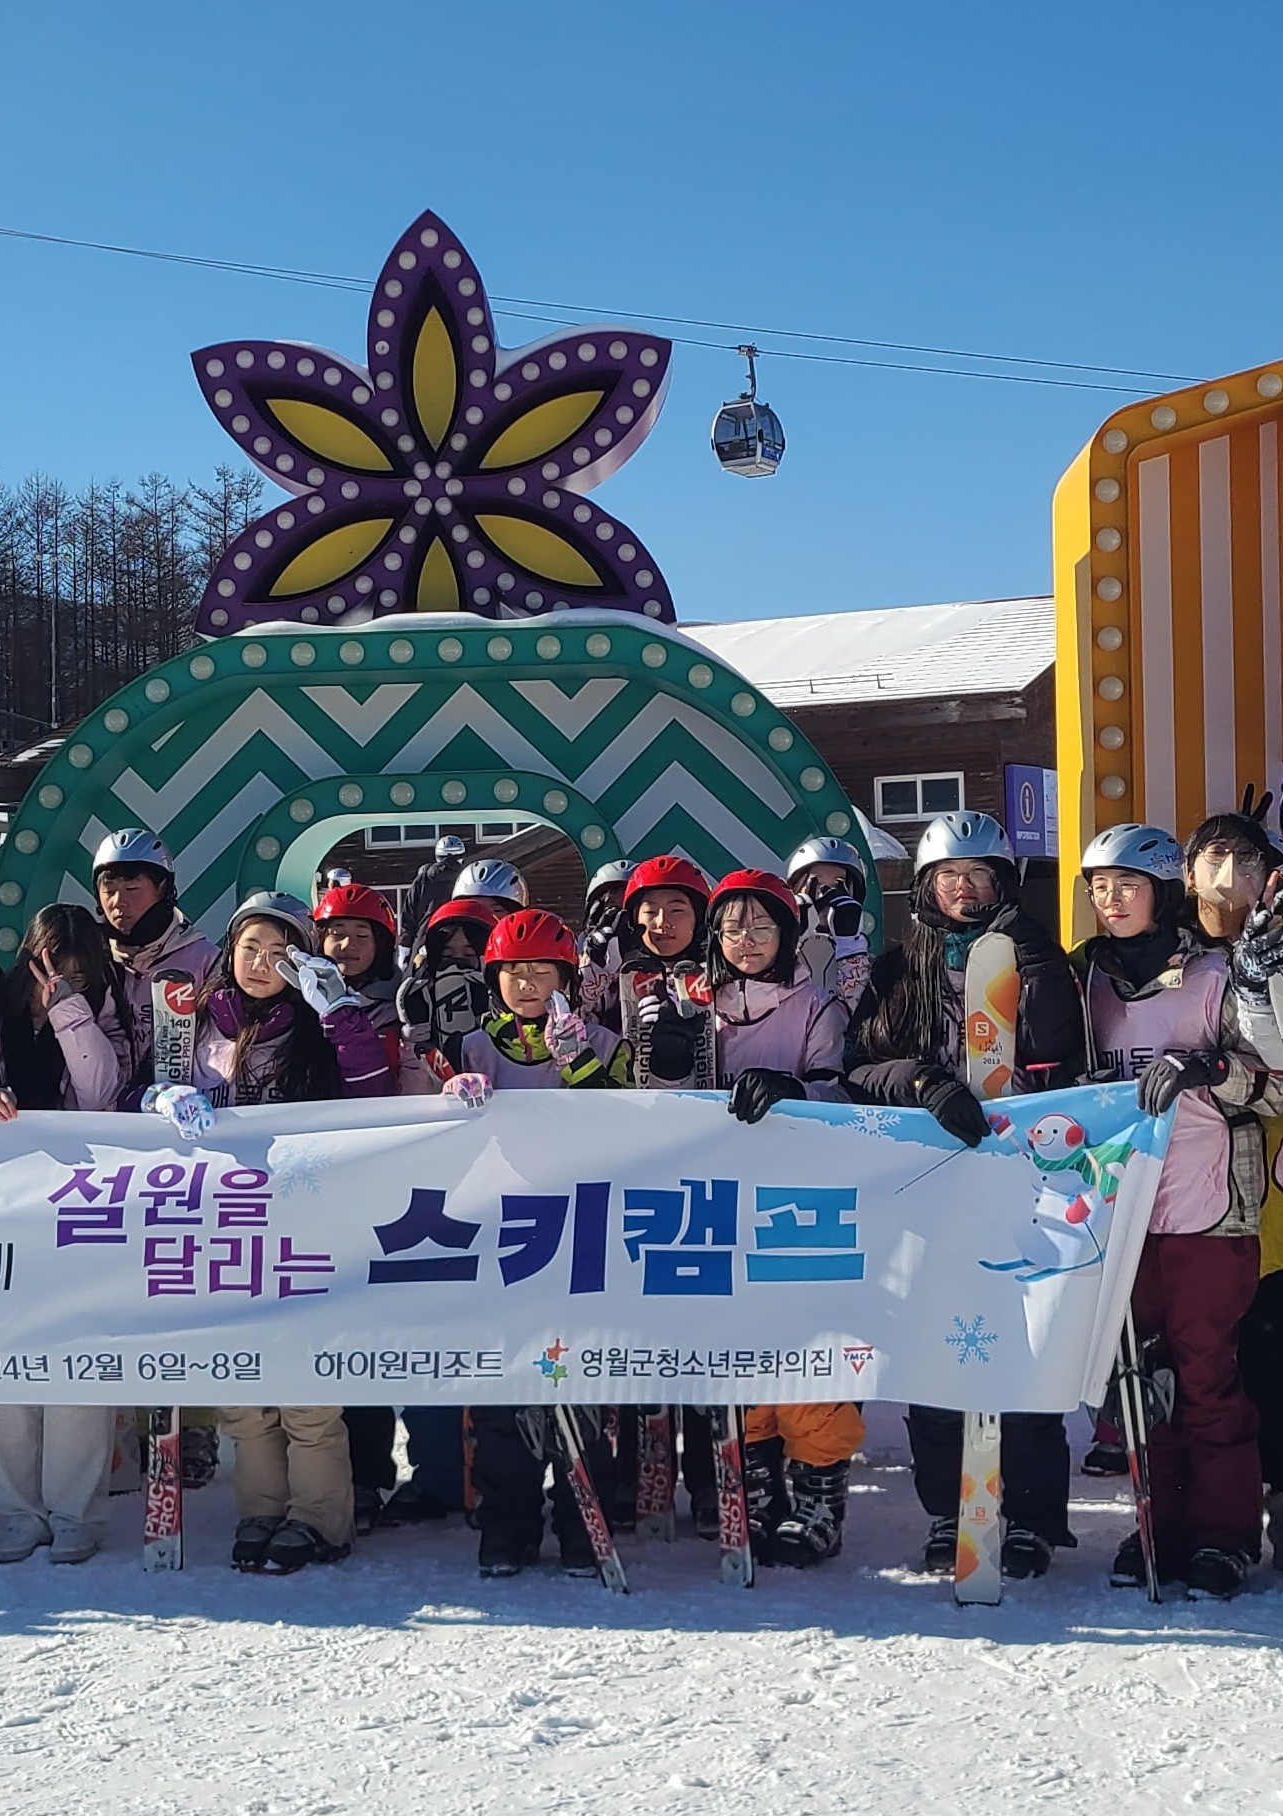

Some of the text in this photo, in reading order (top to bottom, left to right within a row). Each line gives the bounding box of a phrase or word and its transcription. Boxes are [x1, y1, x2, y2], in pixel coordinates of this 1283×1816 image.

[169, 1018, 191, 1029] 140
[182, 1037, 191, 1059] PRO
[168, 1031, 182, 1084] IGNOL
[47, 1161, 273, 1248] 설원을
[367, 1178, 866, 1296] 스키캠프
[143, 1234, 336, 1299] 달리는
[62, 1352, 124, 1381] 12월
[137, 1351, 262, 1381] 6일~8일
[314, 1350, 504, 1380] 하이원리조트
[580, 1347, 833, 1379] 영월군청소년문화의집
[843, 1352, 875, 1362] YMCA
[144, 1481, 164, 1537] PMC
[637, 1461, 654, 1514] PMC
[158, 1496, 175, 1539] PRO
[719, 1492, 732, 1550] PMC
[729, 1504, 742, 1551] PRO
